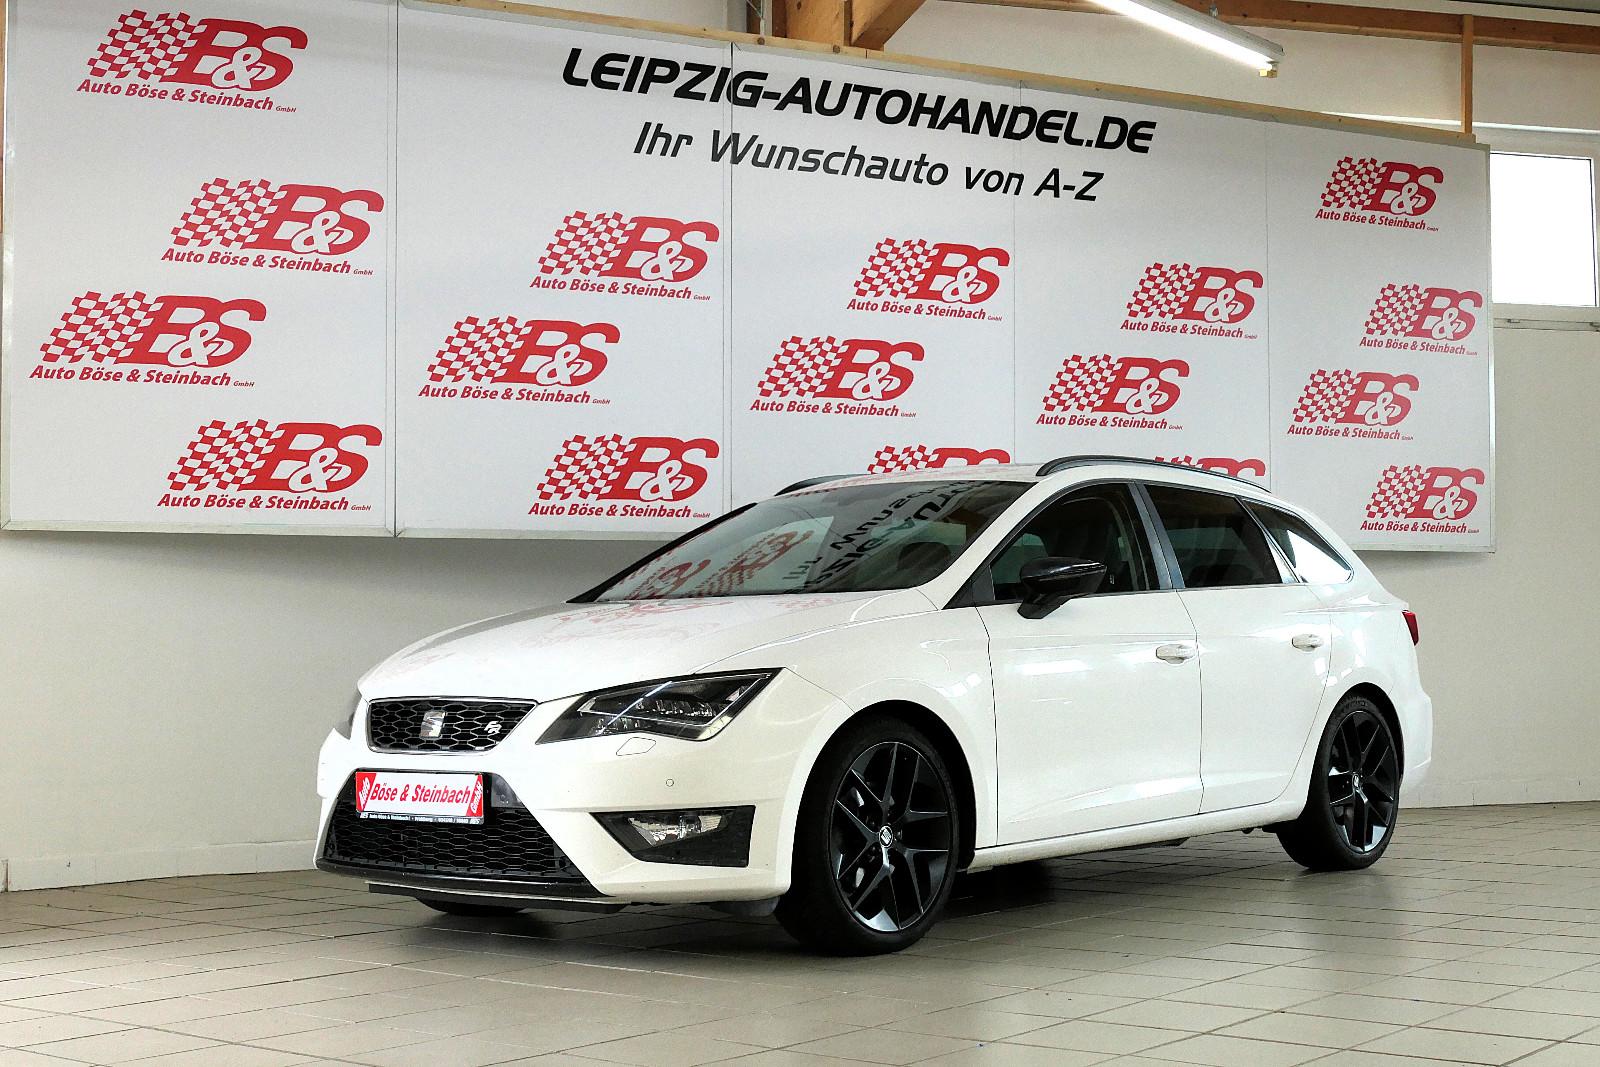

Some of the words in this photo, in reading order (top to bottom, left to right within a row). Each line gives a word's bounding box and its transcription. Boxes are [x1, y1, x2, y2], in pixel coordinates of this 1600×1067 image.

[78, 79, 122, 95] Auto
[124, 83, 169, 101] Böse
[170, 88, 185, 101] &
[188, 88, 273, 110] Steinbach
[562, 47, 1157, 154] LEIPZIG-AUTOHANDEL.DE
[633, 121, 693, 158] Ihr
[711, 129, 949, 186] Wunschauto
[965, 166, 1025, 196] von
[1033, 167, 1104, 202] A-Z
[1315, 210, 1342, 221] Auto
[1343, 212, 1368, 223] Böse
[1368, 215, 1376, 224] &
[1378, 216, 1425, 228] Steinbach
[162, 247, 205, 263] Auto
[208, 250, 249, 267] Böse
[252, 254, 267, 268] &
[269, 256, 351, 273] Steinbach
[530, 275, 567, 290] Auto
[570, 278, 606, 292] Böse
[608, 282, 619, 294] &
[622, 282, 693, 299] Steinbach
[848, 299, 878, 312] Auto
[880, 300, 912, 315] Böse
[914, 304, 923, 315] &
[926, 304, 985, 319] Steinbach
[1120, 319, 1148, 332] Auto
[1151, 321, 1178, 333] Böse
[1181, 324, 1188, 334] &
[1191, 322, 1243, 337] Steinbach
[1360, 338, 1383, 348] Auto
[1386, 340, 1408, 349] Böse
[1410, 342, 1418, 351] &
[1420, 342, 1465, 354] Steinbach
[30, 364, 76, 381] Auto
[78, 366, 124, 383] Böse
[126, 368, 141, 383] &
[144, 369, 231, 385] Steinbach
[419, 384, 458, 399] Auto
[461, 385, 498, 400] Böse
[500, 386, 513, 400] &
[516, 387, 590, 403] Steinbach
[751, 399, 784, 415] Auto
[787, 400, 820, 413] Böse
[823, 402, 833, 414] &
[835, 403, 900, 416] Steinbach
[1036, 414, 1066, 426] Auto
[1069, 414, 1097, 426] Böse
[1099, 416, 1108, 427] &
[1111, 416, 1168, 429] Steinbach
[1288, 425, 1313, 435] Auto
[1315, 425, 1341, 436] Böse
[1342, 427, 1350, 438] &
[1352, 428, 1400, 439] Steinbach
[157, 493, 202, 512] Auto
[205, 493, 247, 509] Böse
[249, 495, 263, 509] &
[264, 495, 350, 511] Steinbach
[528, 501, 566, 516] Auto
[567, 503, 604, 517] Böse
[606, 504, 618, 516] &
[620, 503, 692, 519] Steinbach
[1360, 521, 1385, 531] Auto
[1386, 521, 1410, 531] Böse
[1411, 522, 1418, 532] &
[1420, 522, 1467, 532] Steinbach
[370, 782, 398, 801] Böse
[400, 784, 410, 802] &
[412, 784, 471, 804] Steinbach
